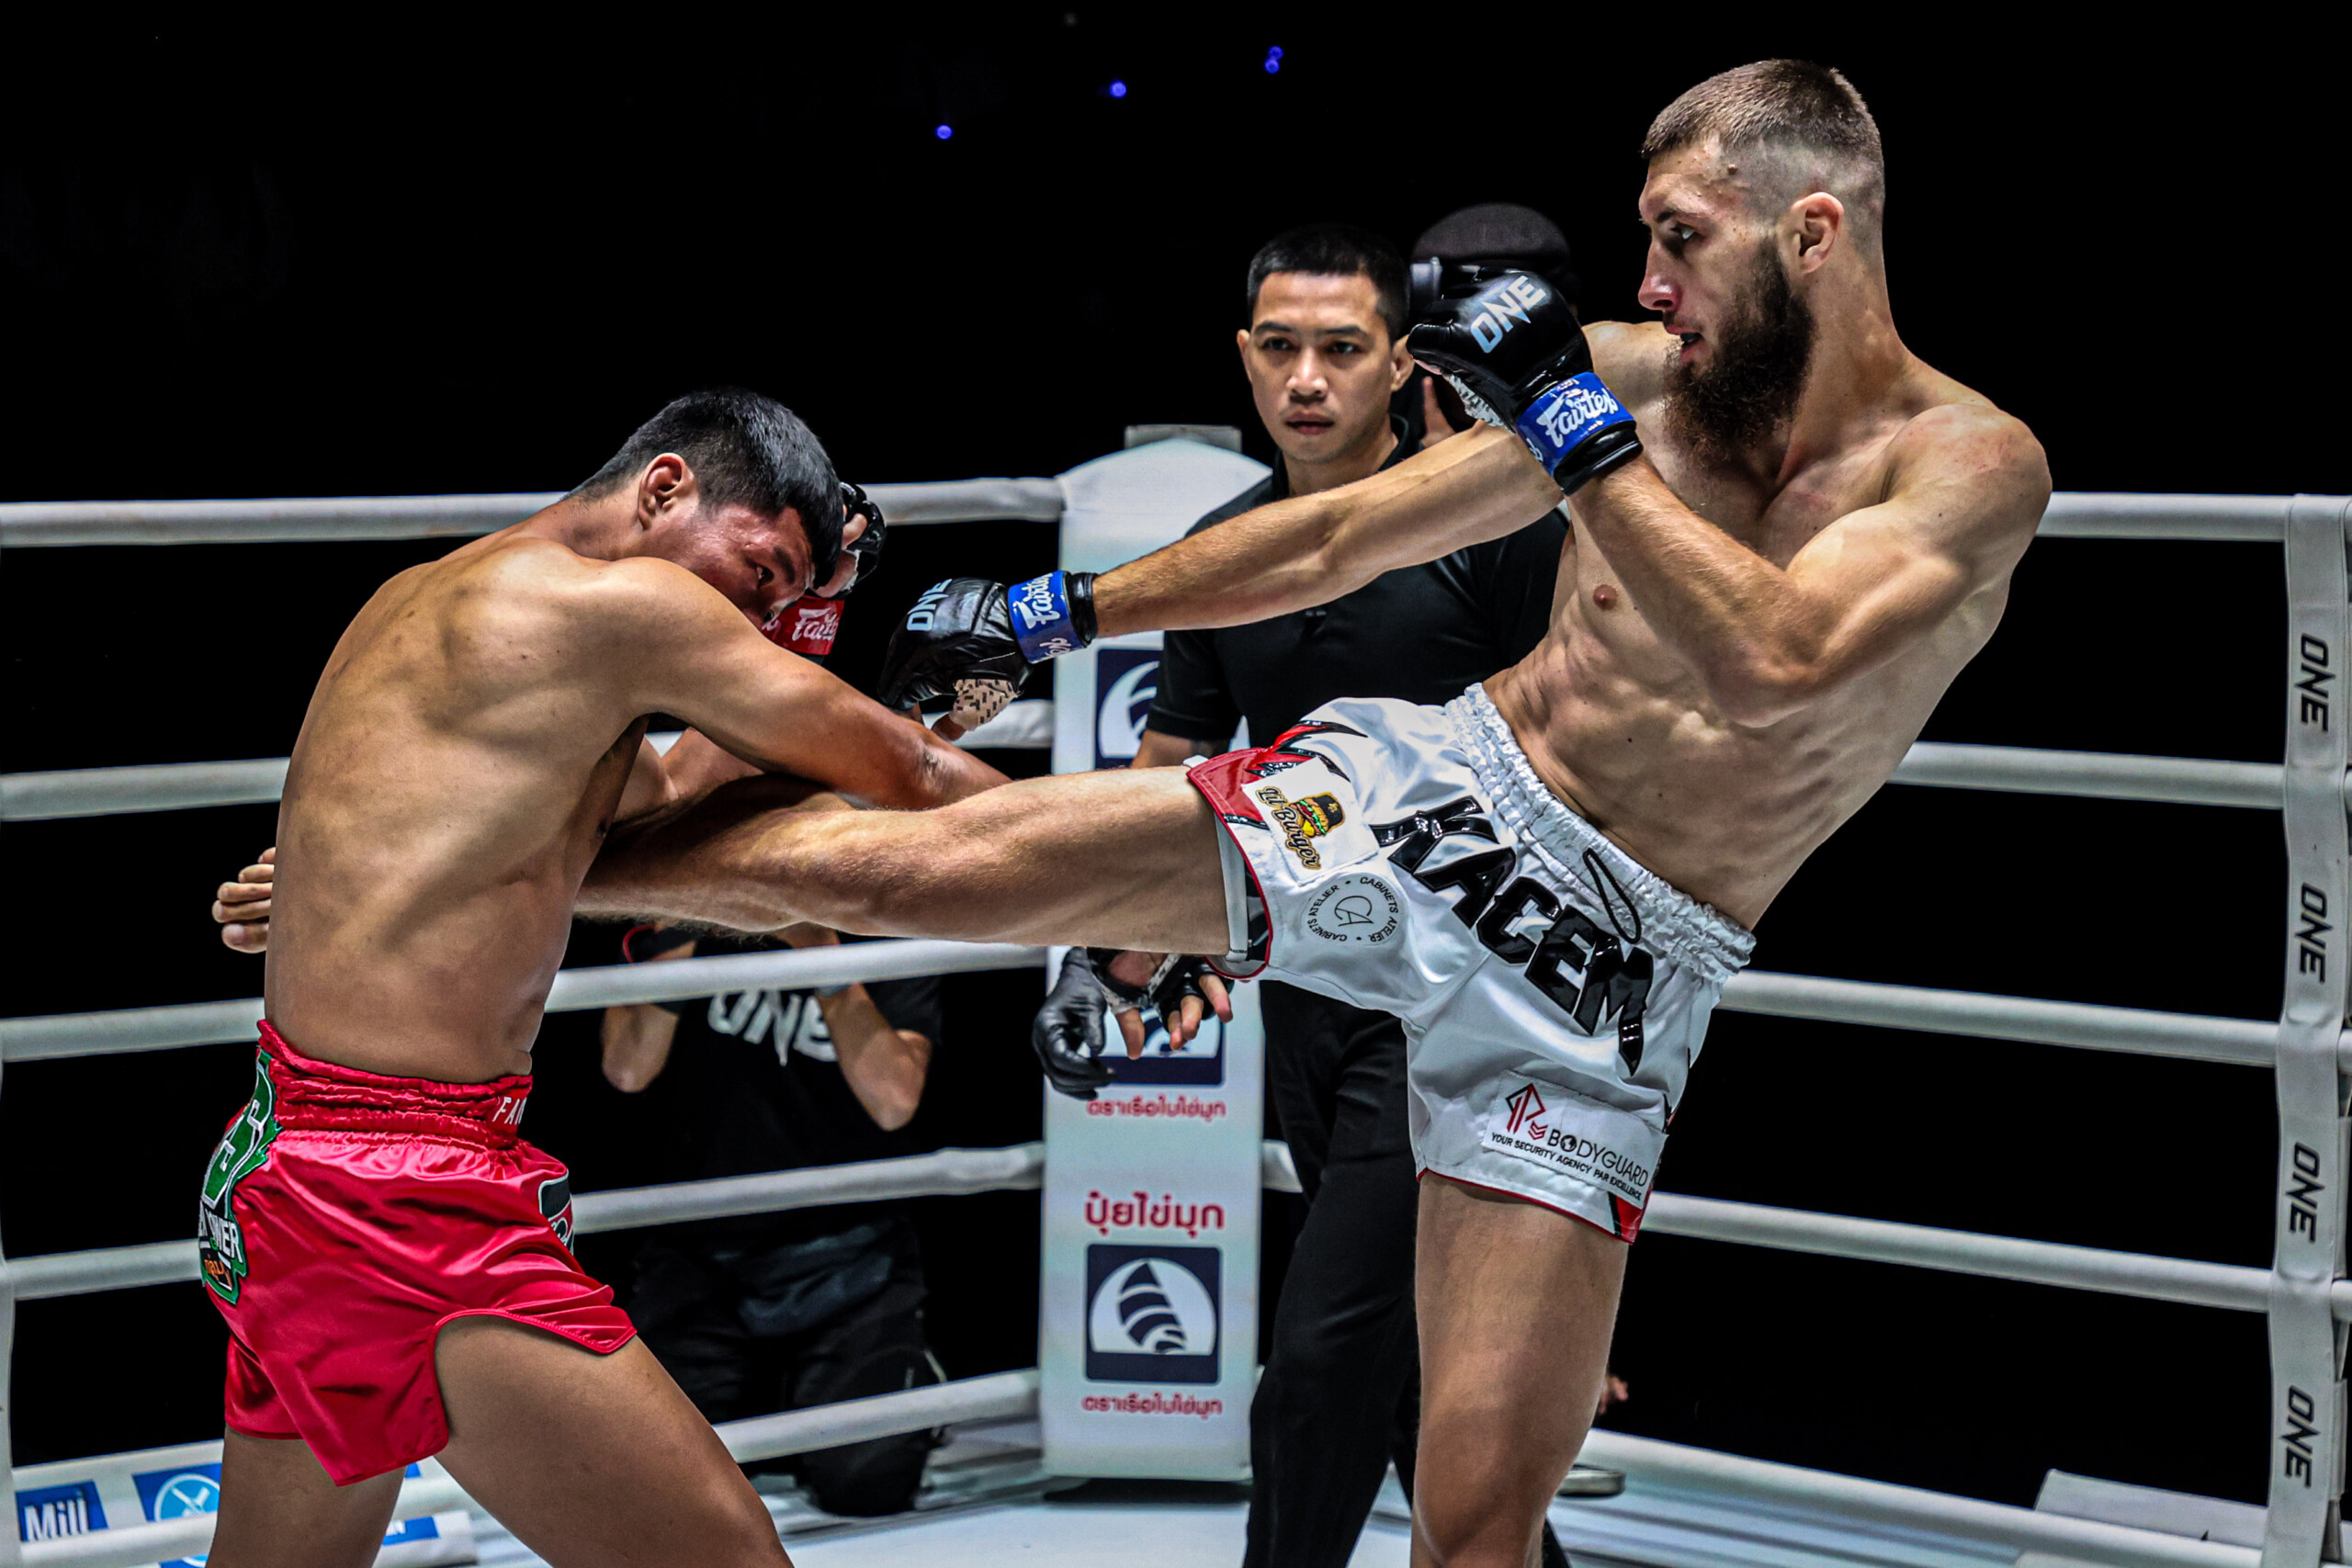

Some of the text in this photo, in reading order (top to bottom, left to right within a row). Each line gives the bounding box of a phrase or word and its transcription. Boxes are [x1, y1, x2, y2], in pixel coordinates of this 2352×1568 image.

[1471, 276, 1546, 353] ONE
[1536, 388, 1619, 448] Fairtex
[906, 579, 953, 631] ONE
[2294, 632, 2336, 733] ONE
[1273, 807, 1321, 869] Burger
[1307, 885, 1348, 942] CABINETS ATELIER
[1360, 876, 1398, 942] CABINETS ATELIER
[1368, 795, 1654, 1077] KACEM
[2294, 882, 2335, 985] ONE
[1491, 1132, 1643, 1201] YOUR SECURITY AGENCY PAR EXCELLENCE
[1547, 1129, 1649, 1187] BODYGUARD
[2285, 1141, 2325, 1244] ONE
[2278, 1384, 2322, 1488] ONE
